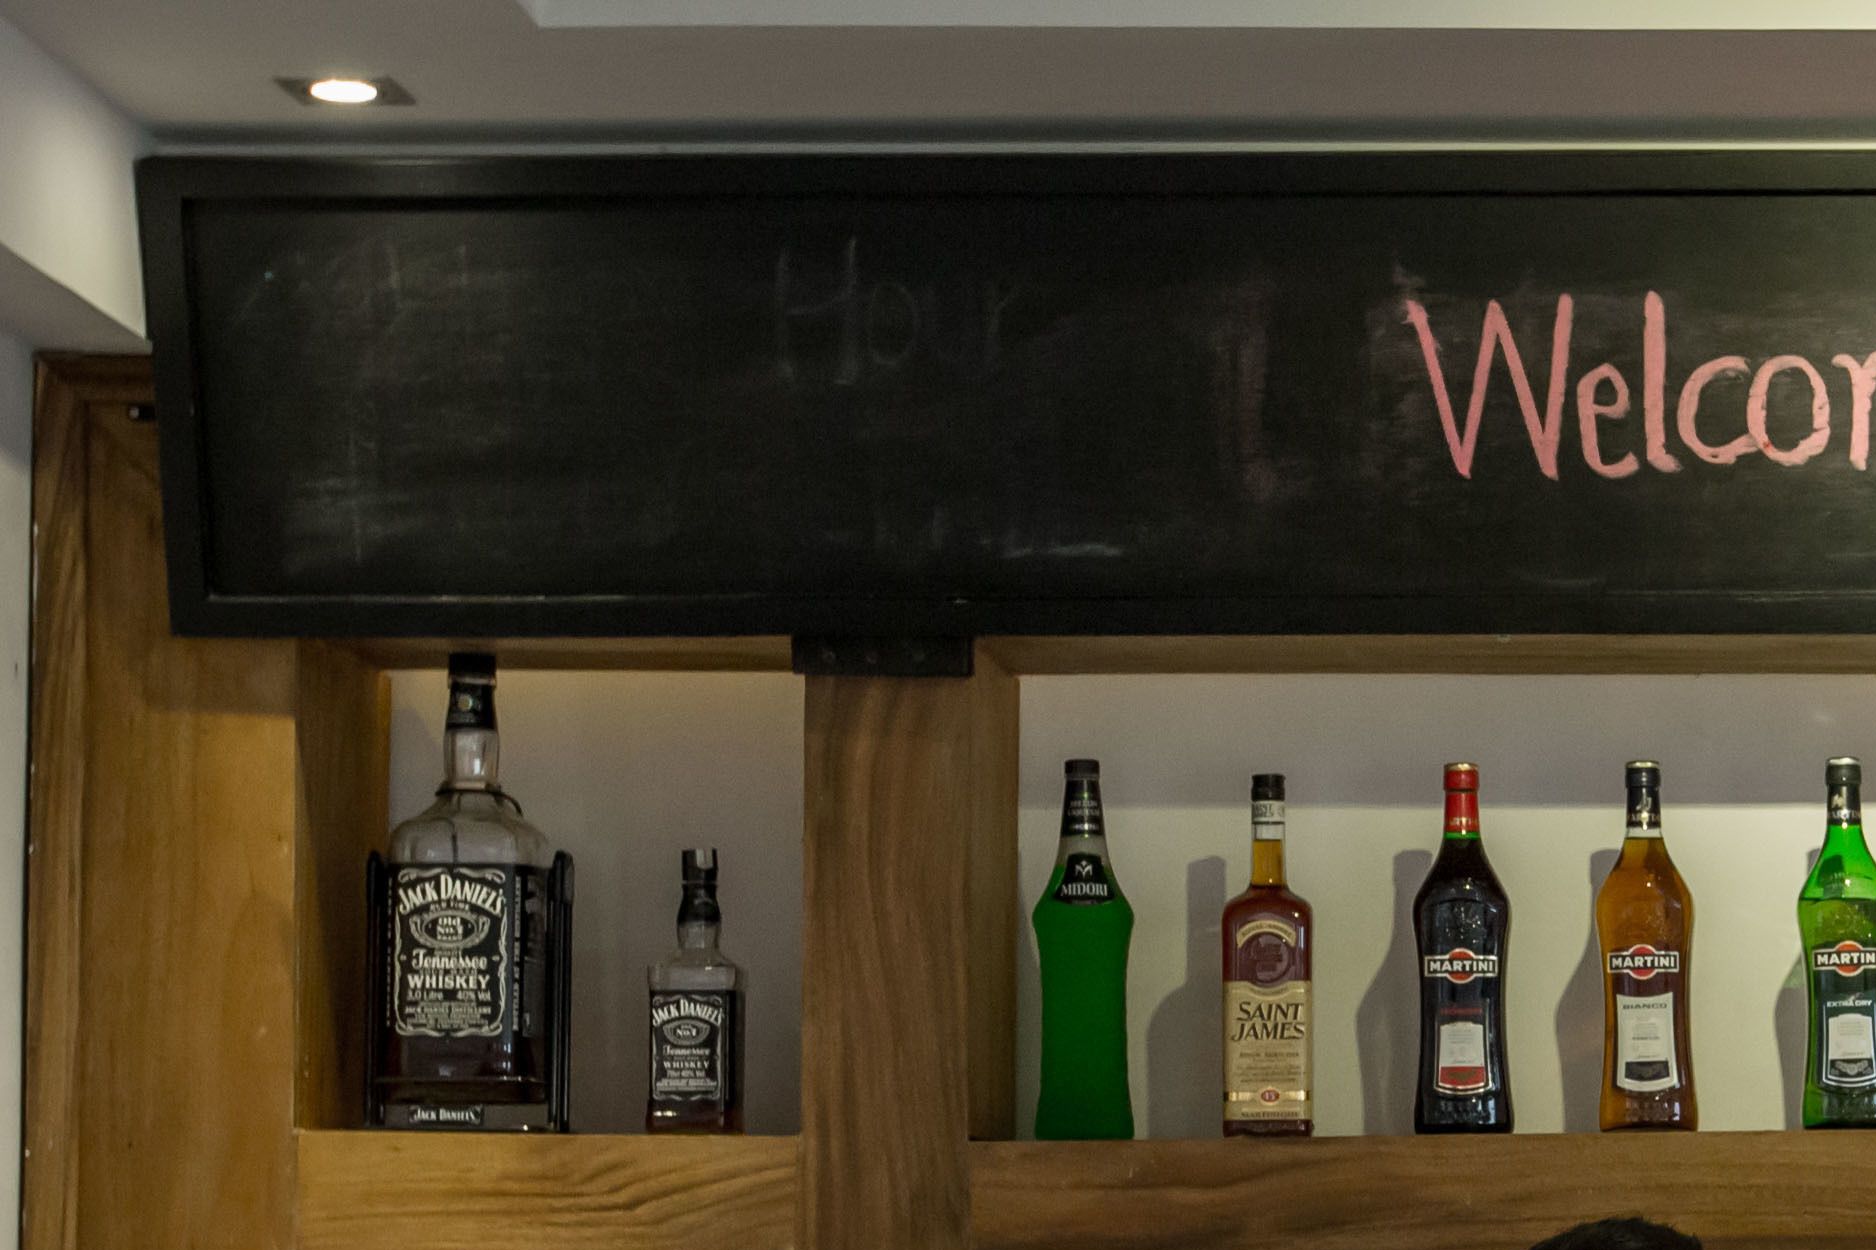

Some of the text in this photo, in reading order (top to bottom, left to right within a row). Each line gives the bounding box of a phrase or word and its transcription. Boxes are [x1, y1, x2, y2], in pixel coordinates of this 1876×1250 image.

[398, 873, 507, 917] JACK DANIEL'S
[1060, 882, 1108, 897] MIDORI
[411, 948, 488, 970] Tennessee
[1429, 960, 1493, 973] MARTINI
[1611, 955, 1675, 969] MARTINI
[407, 973, 491, 990] WHISKEY
[652, 1003, 680, 1028] JACK
[1236, 1000, 1305, 1022] SAINT
[1230, 1022, 1305, 1042] JAMES
[663, 1060, 710, 1069] WHISKEY
